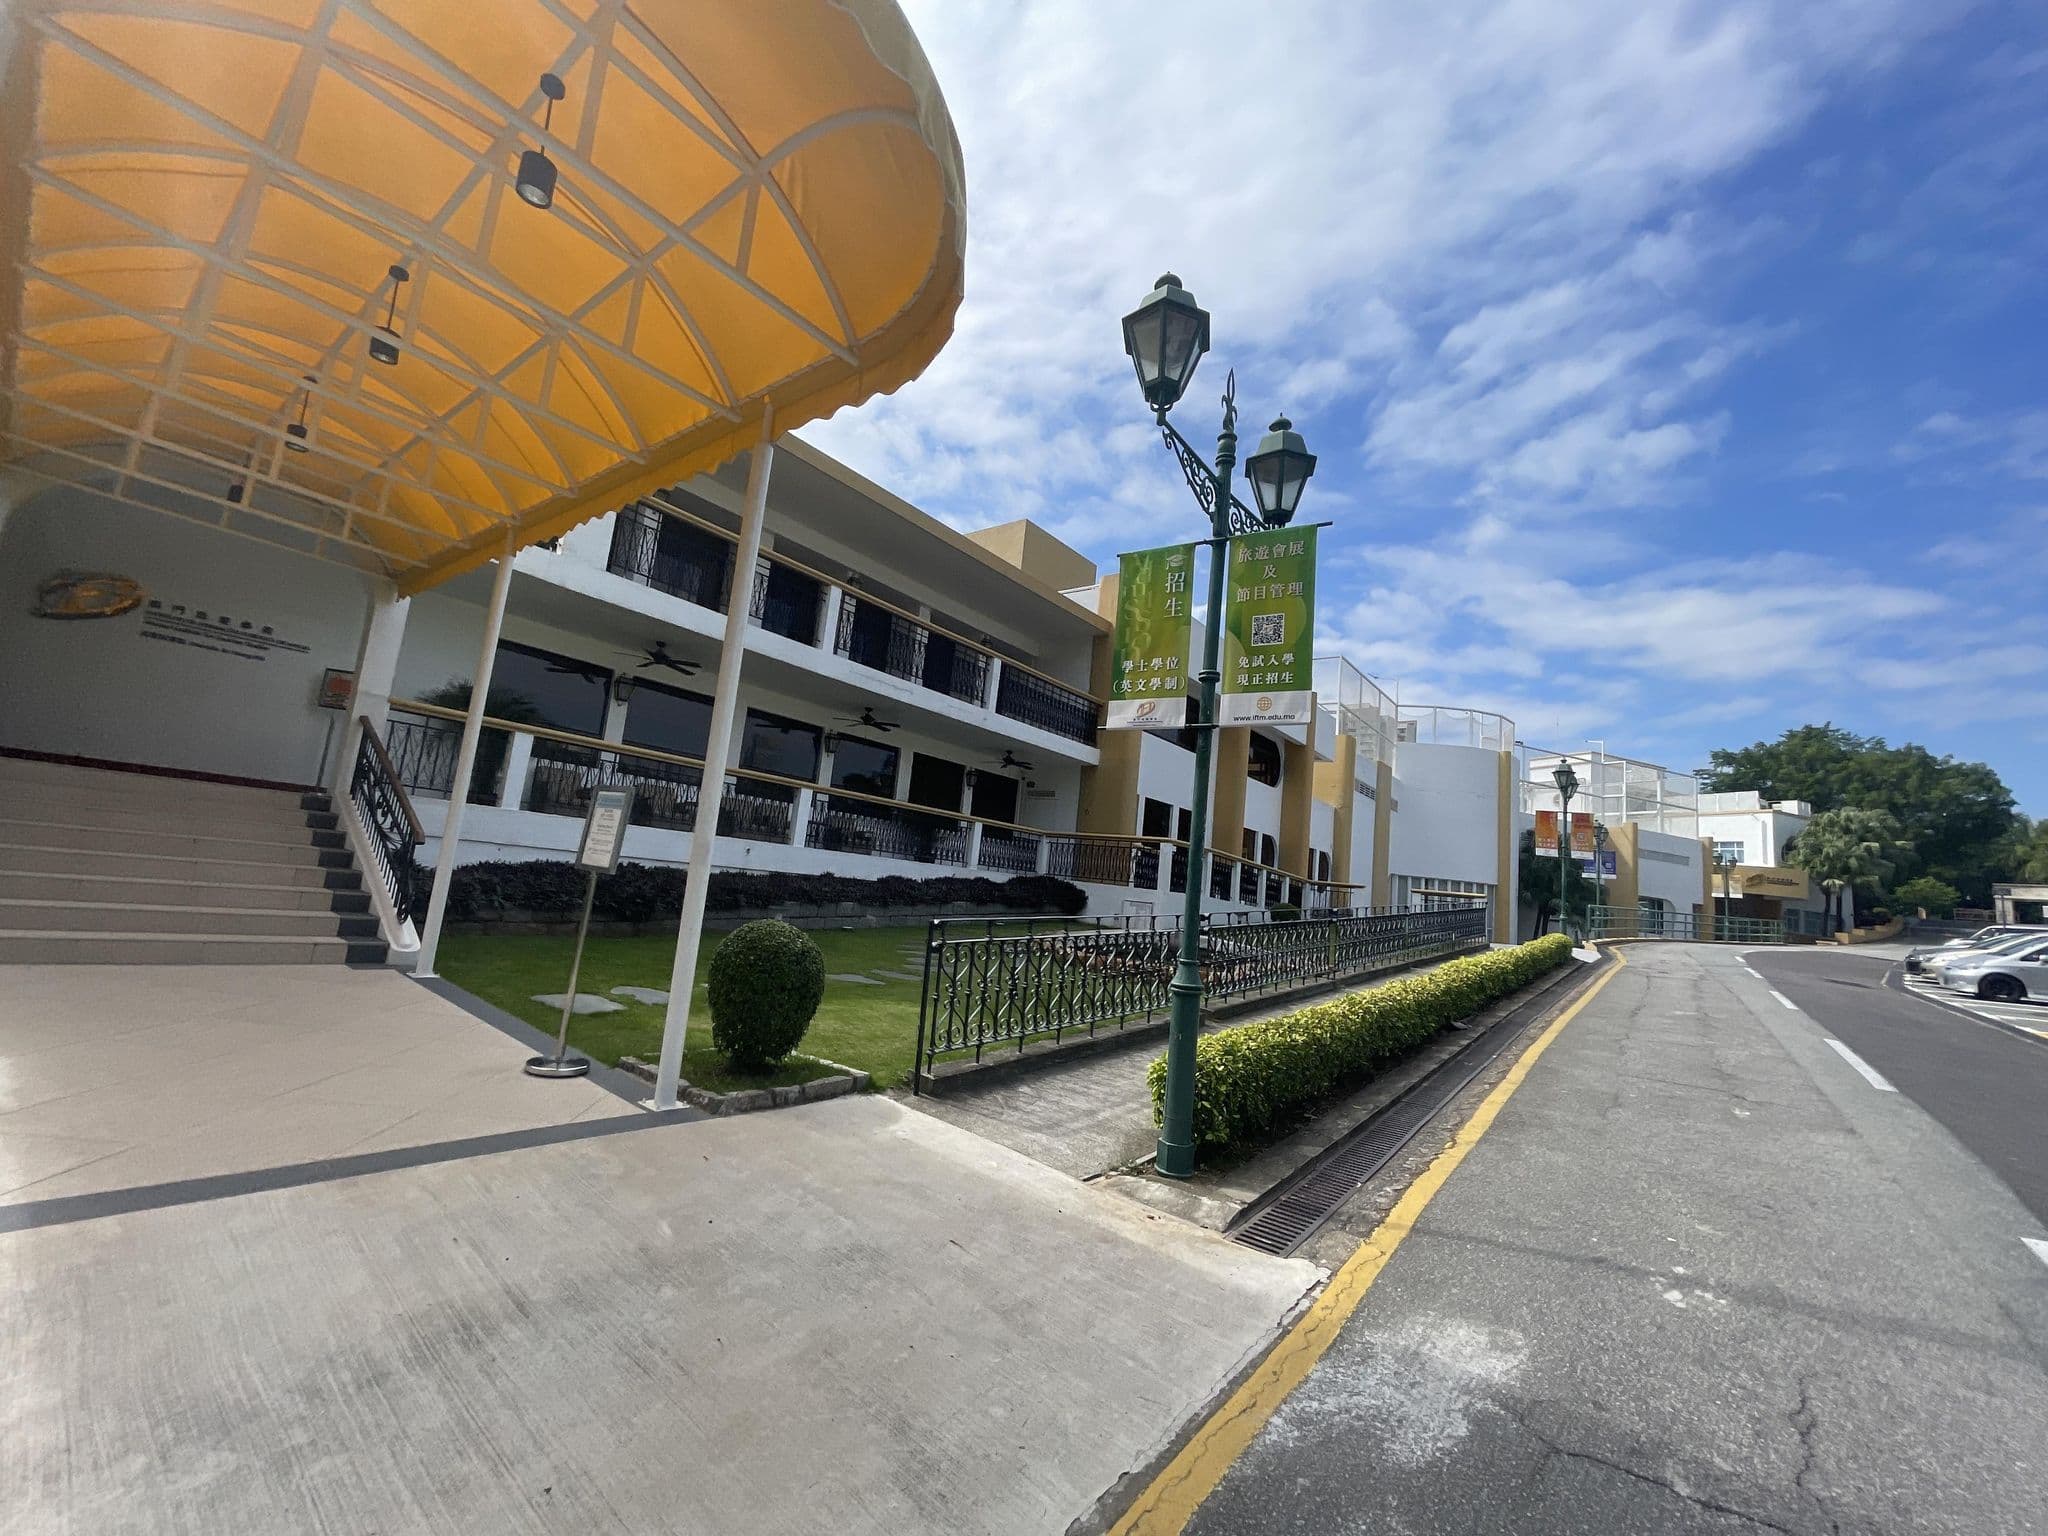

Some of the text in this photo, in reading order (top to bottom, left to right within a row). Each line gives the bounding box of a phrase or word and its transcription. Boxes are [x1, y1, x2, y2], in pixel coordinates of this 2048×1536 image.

[1238, 540, 1304, 562] 旅遊會展
[1262, 566, 1278, 579] 及
[1163, 572, 1185, 618] 招生
[1236, 581, 1304, 603] 節目管理
[1121, 656, 1180, 673] 學士學位
[1238, 653, 1295, 668] 免試入學
[1236, 671, 1294, 686] 現正招生
[1233, 713, 1295, 723] www.iftm.edu.mo
